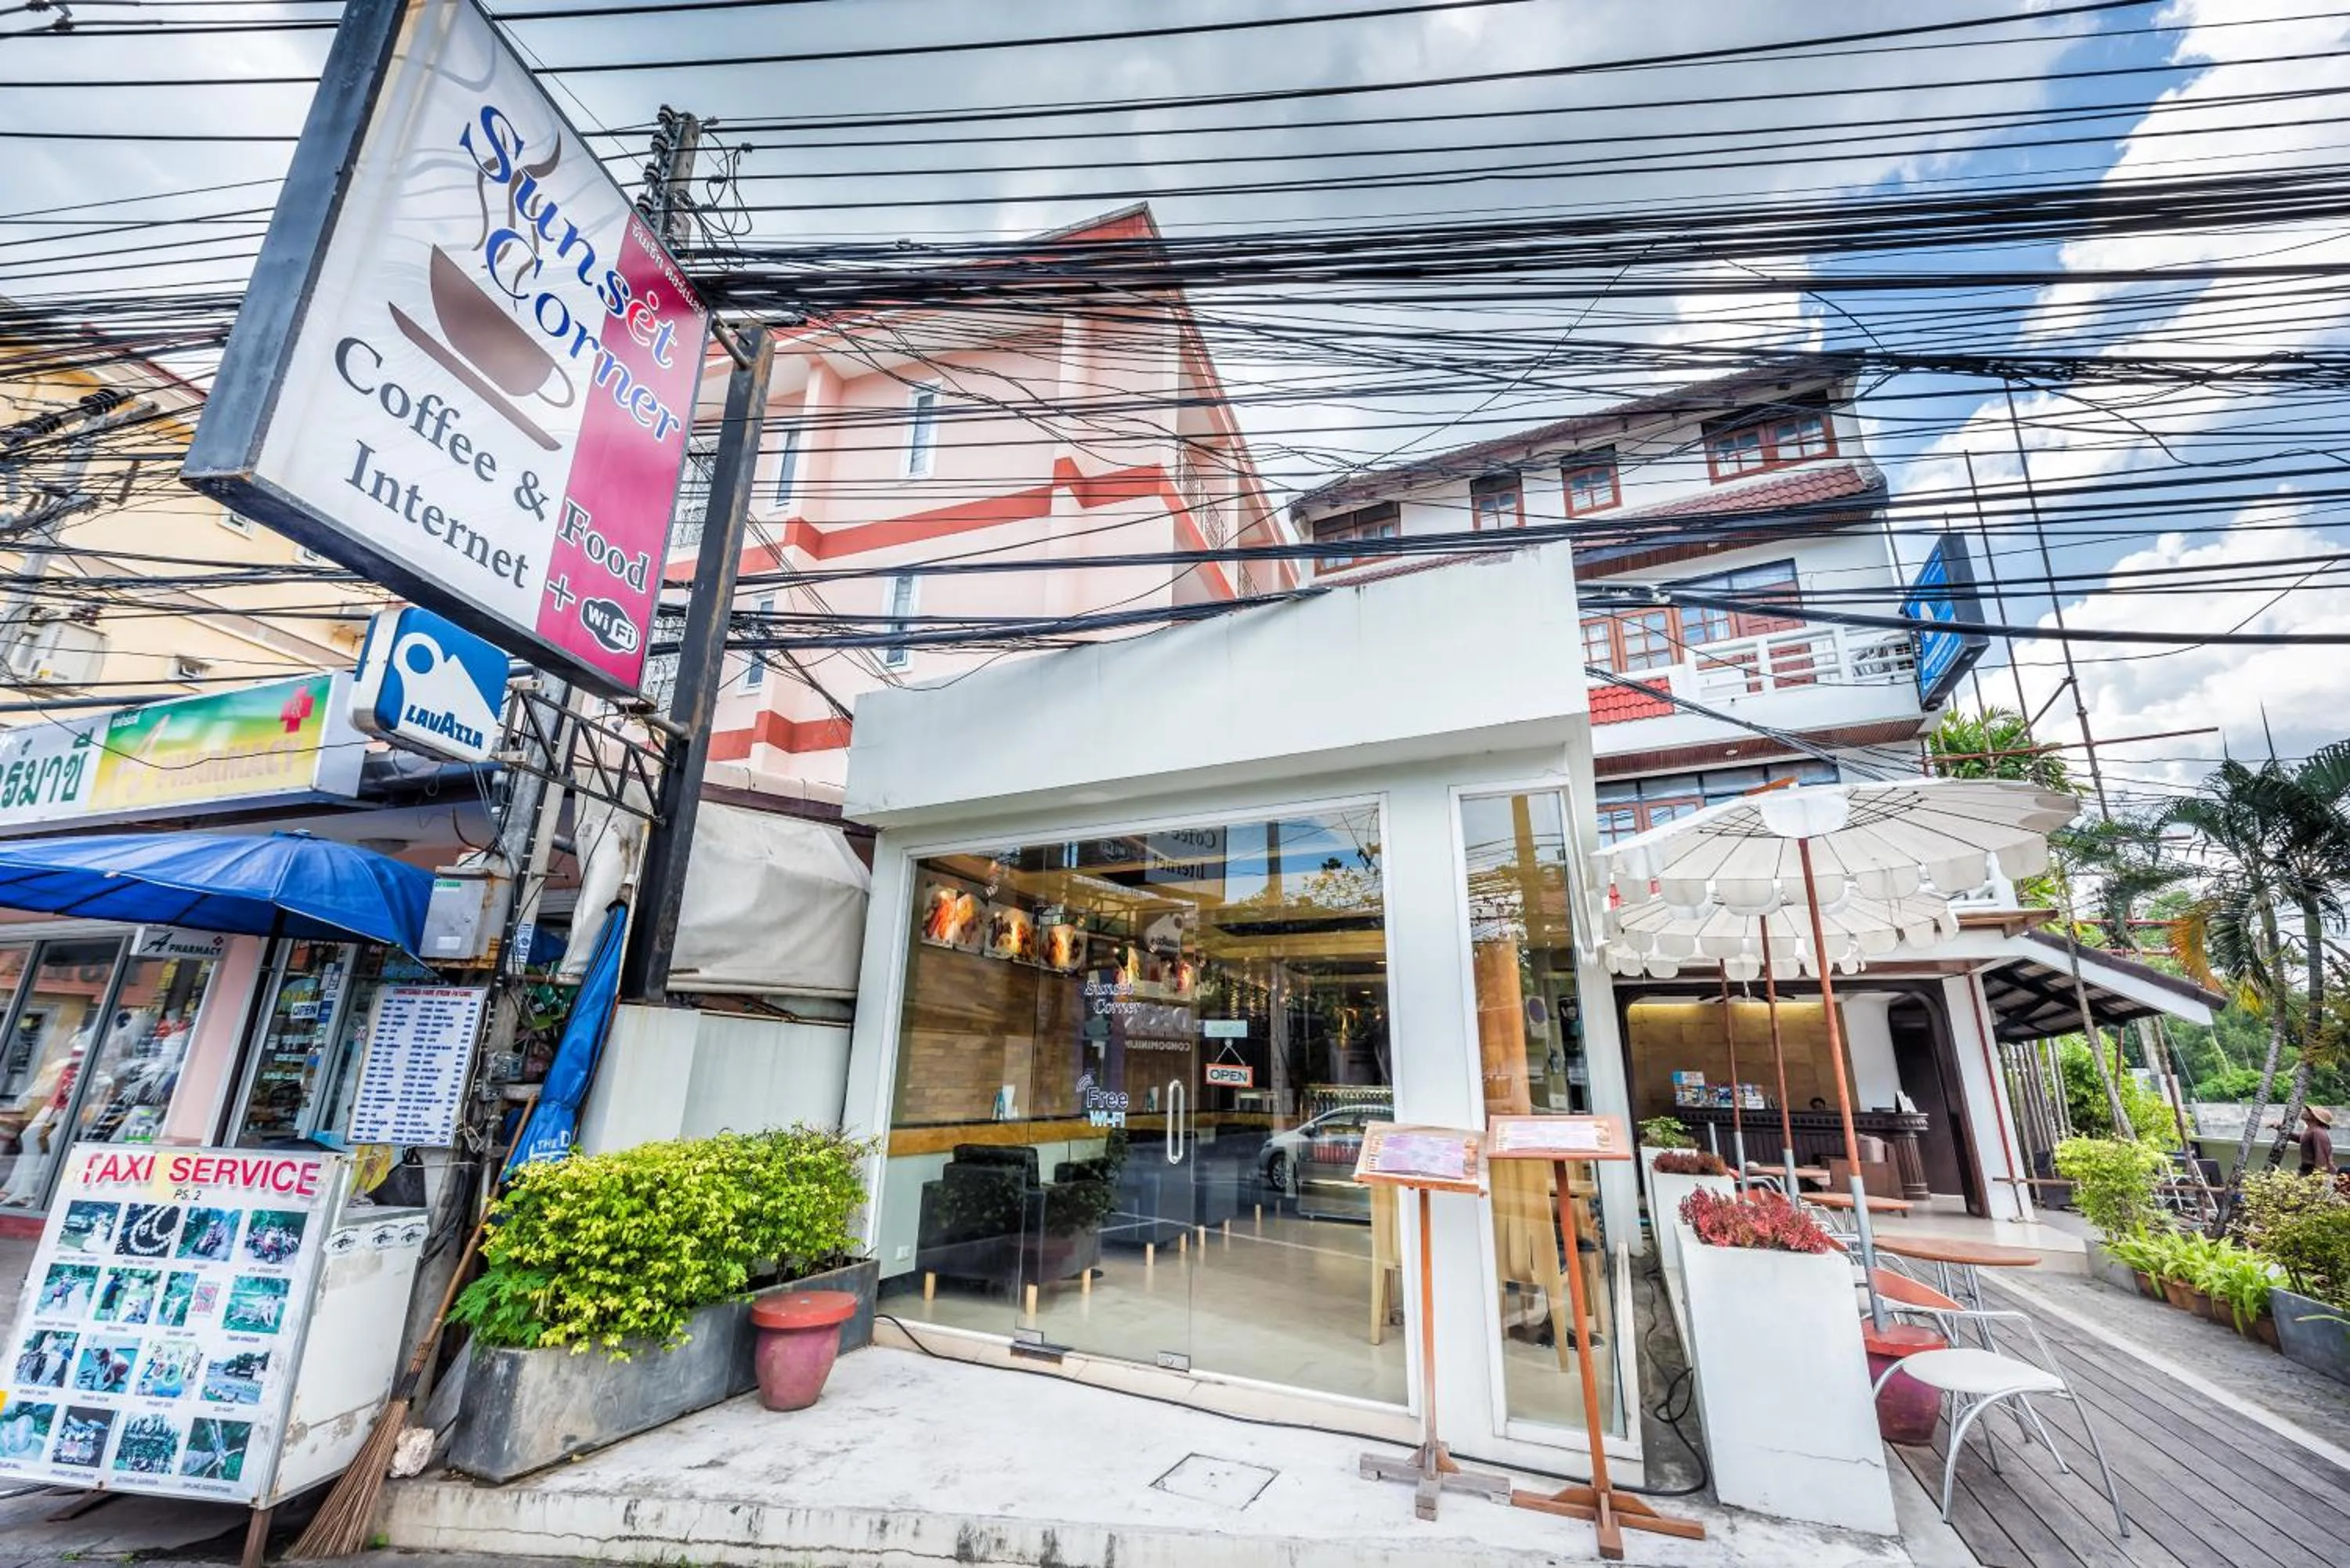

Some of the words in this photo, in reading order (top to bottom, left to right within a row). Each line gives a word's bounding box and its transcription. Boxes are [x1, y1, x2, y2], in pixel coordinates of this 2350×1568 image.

[461, 106, 676, 368] Sunset
[486, 229, 681, 443] Corner
[334, 337, 497, 482] Coffee
[514, 471, 551, 522] &
[559, 501, 649, 592] Food
[345, 439, 530, 588] Internet
[405, 704, 483, 750] LAVAZZA
[168, 944, 222, 955] PHARMACY
[1084, 981, 1135, 995] Sunset
[1094, 999, 1141, 1014] Corner
[1086, 1086, 1129, 1108] Free
[1209, 1069, 1248, 1082] OPEN
[82, 1152, 156, 1185] TAXI
[168, 1156, 321, 1197] SERVICE
